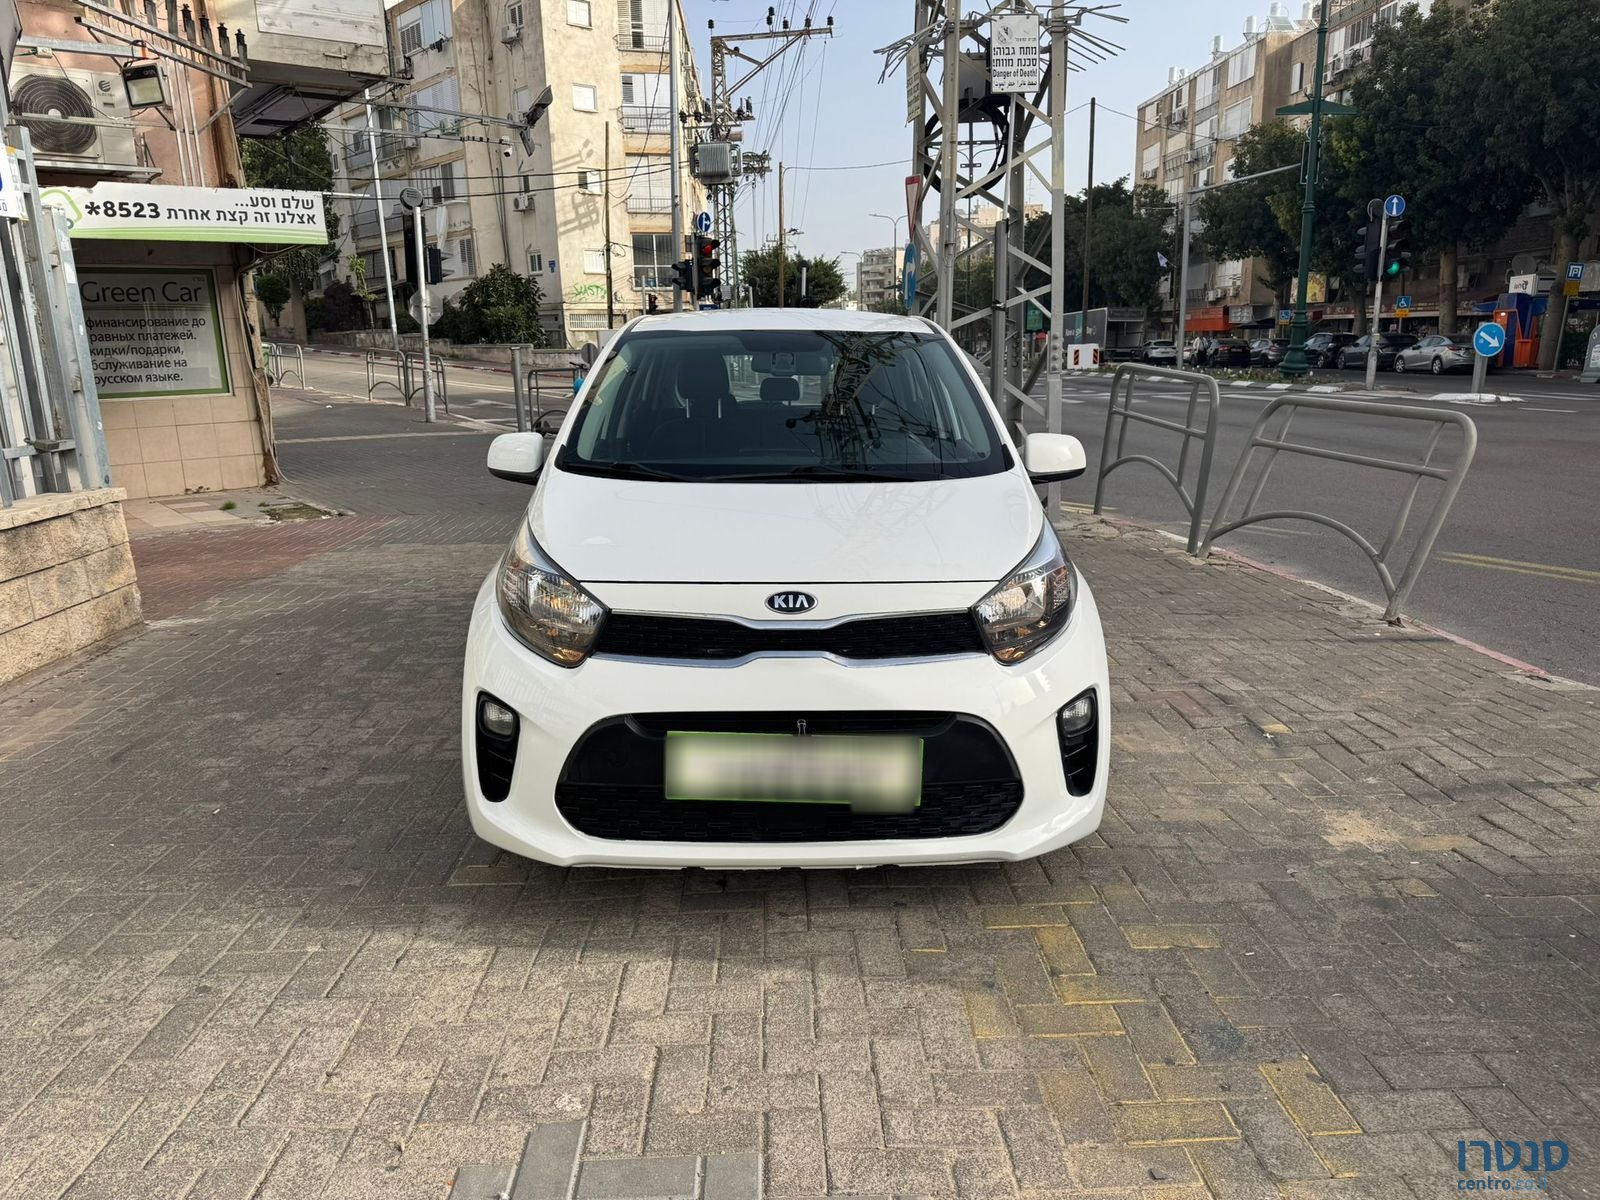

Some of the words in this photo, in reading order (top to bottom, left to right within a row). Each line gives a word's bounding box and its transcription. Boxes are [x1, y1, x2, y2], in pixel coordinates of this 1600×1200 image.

[993, 46, 1015, 56] גבוה!
[1019, 46, 1037, 55] מתח
[1017, 58, 1037, 67] סכנת
[992, 69, 1012, 79] Danger
[1013, 69, 1019, 77] of
[1020, 68, 1037, 77] Death!
[235, 195, 276, 208] וסע...
[282, 196, 314, 210] שלם
[167, 208, 210, 221] אחרת
[216, 209, 249, 226] קצת
[254, 210, 270, 223] זה
[276, 211, 316, 225] אצלנו
[81, 281, 156, 303] Green
[162, 281, 202, 303] Car
[86, 317, 189, 331] финансирование
[191, 317, 206, 328] до
[90, 332, 135, 345] равных
[138, 329, 197, 342] платежей.
[90, 344, 184, 358] кидки/подарки,
[92, 359, 171, 373] бслуживание
[174, 359, 187, 368] на
[145, 372, 183, 383] языке.
[773, 594, 809, 608] KIA
